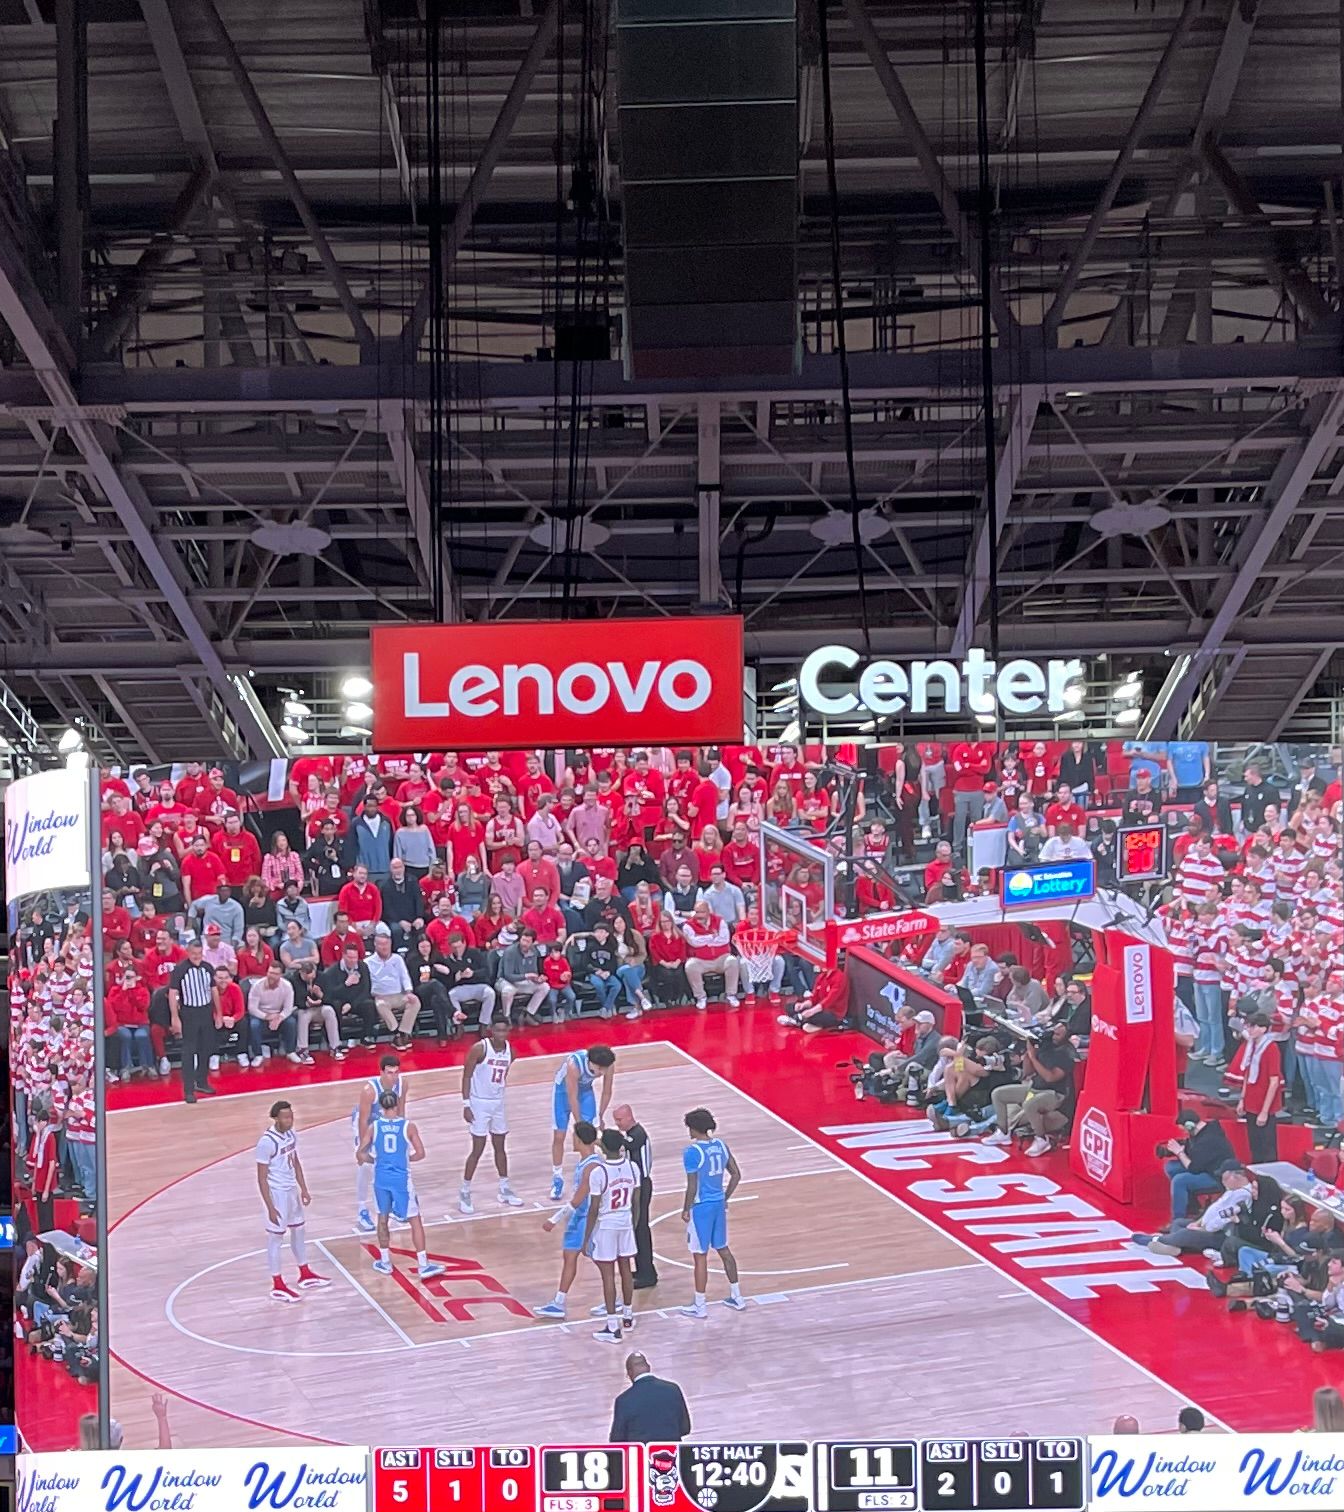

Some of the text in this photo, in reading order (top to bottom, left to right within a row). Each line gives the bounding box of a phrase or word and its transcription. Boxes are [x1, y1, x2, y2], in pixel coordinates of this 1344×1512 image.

[403, 644, 1083, 718] Lenovo Center
[1034, 878, 1087, 896] Lottery
[1131, 952, 1145, 1017] Lenovo
[1083, 1127, 1113, 1161] CPI
[610, 1187, 630, 1210] 21
[819, 1118, 1211, 1300] NC STATE
[383, 1449, 523, 1467] AST STL TO
[692, 1445, 763, 1461] 1ST HALF
[930, 1442, 1070, 1460] AST STL TO
[560, 1452, 609, 1489] 18
[690, 1462, 767, 1487] 12:40
[849, 1447, 898, 1486] 11
[1092, 1450, 1216, 1498] Window
[101, 1464, 222, 1512] Window
[244, 1461, 368, 1510] Window
[392, 1479, 518, 1502] 5 1 0
[938, 1471, 1064, 1496] 2 0 1
[549, 1498, 592, 1511] FLS: 3
[866, 1494, 907, 1506] FLS: 2
